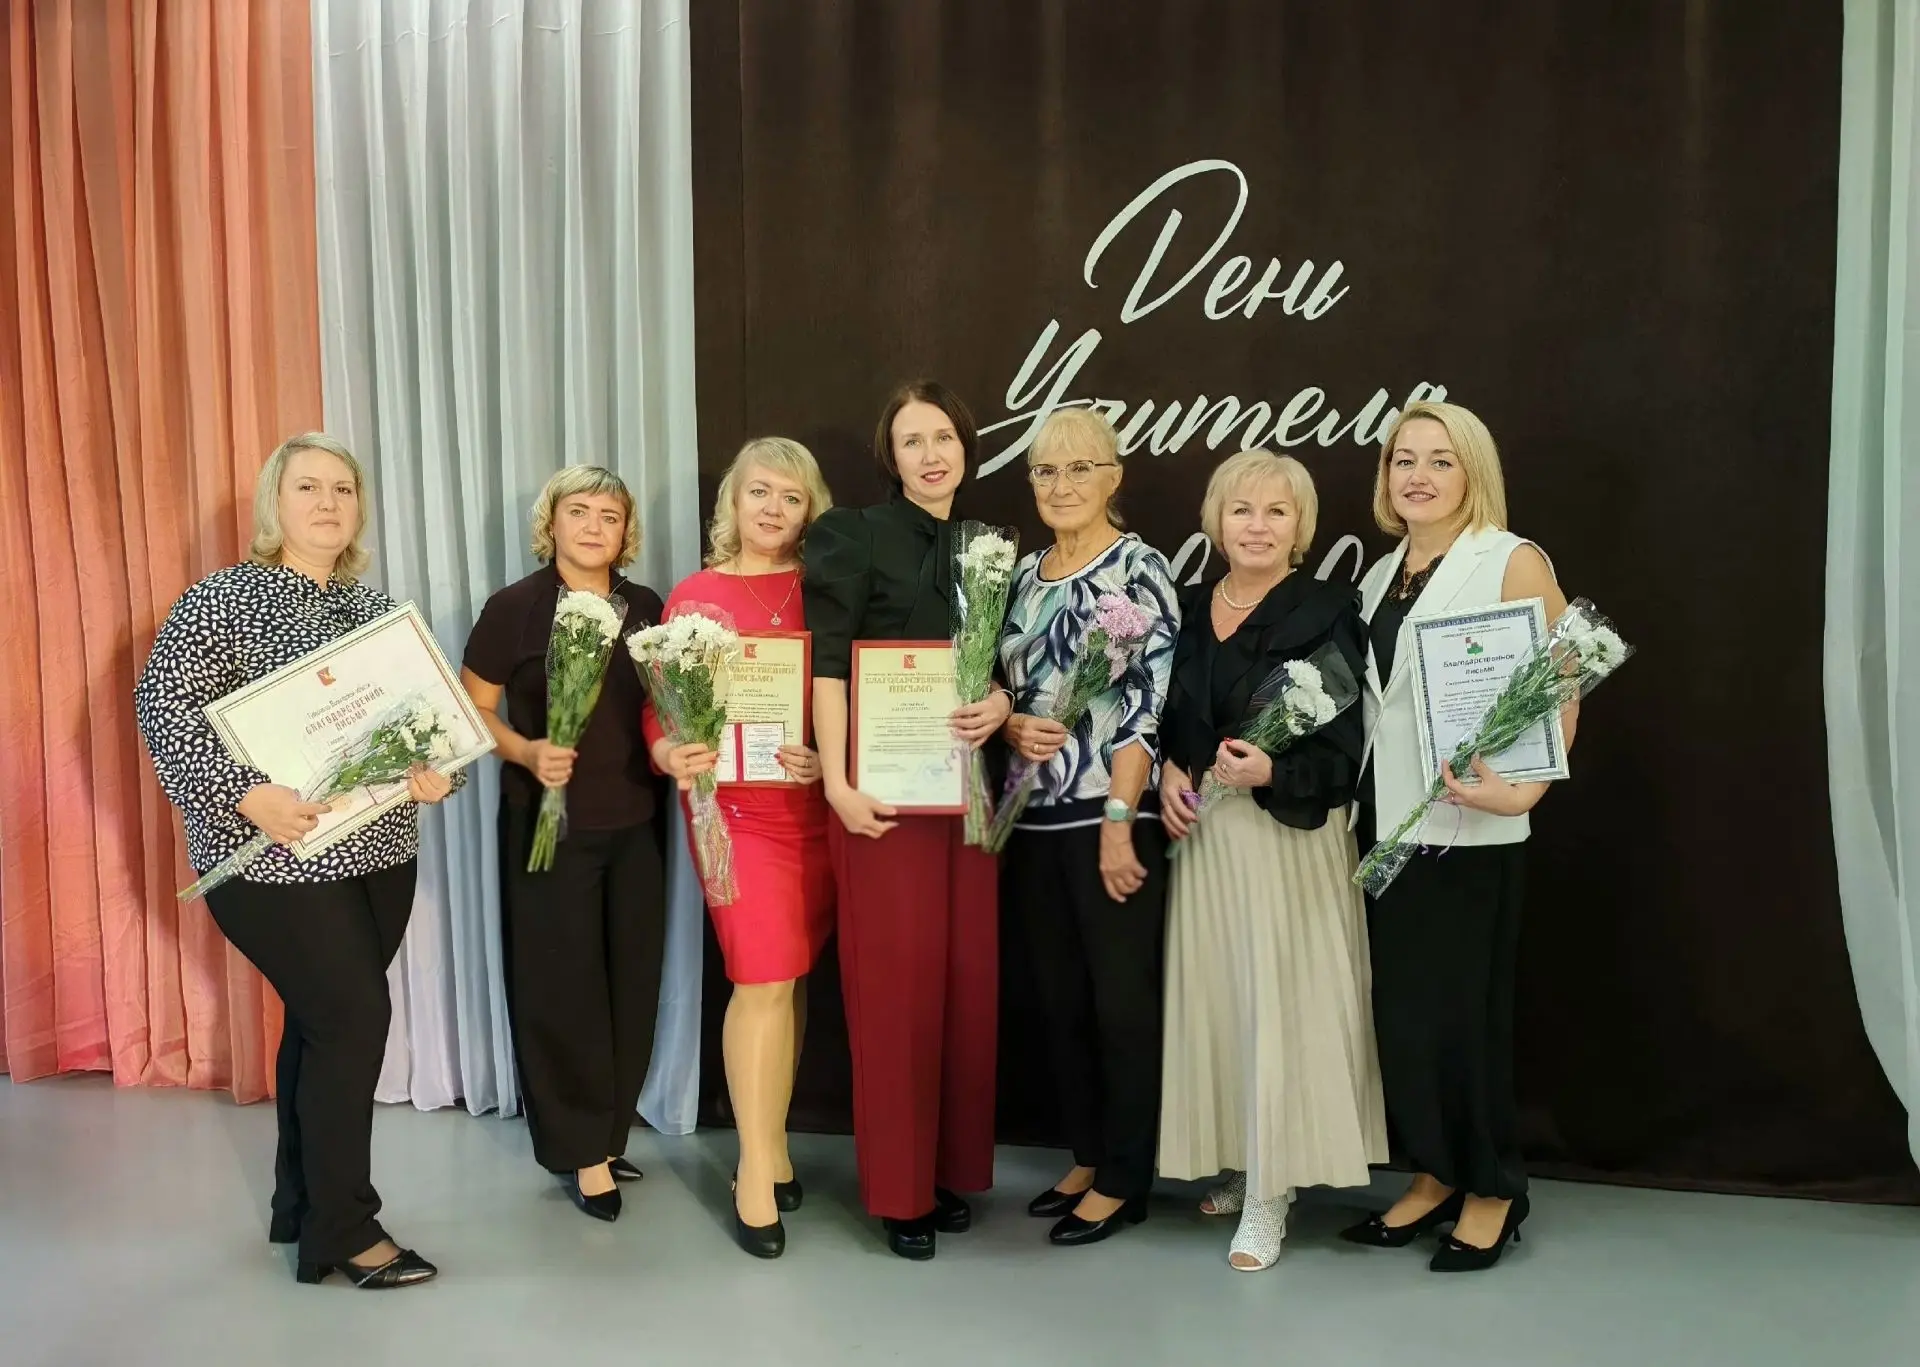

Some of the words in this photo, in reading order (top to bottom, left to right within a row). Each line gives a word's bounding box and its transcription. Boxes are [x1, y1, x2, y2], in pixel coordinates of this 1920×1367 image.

[1084, 159, 1350, 323] День
[888, 684, 934, 693] ПИСЬМО
[334, 708, 368, 732] ПИСЬМО
